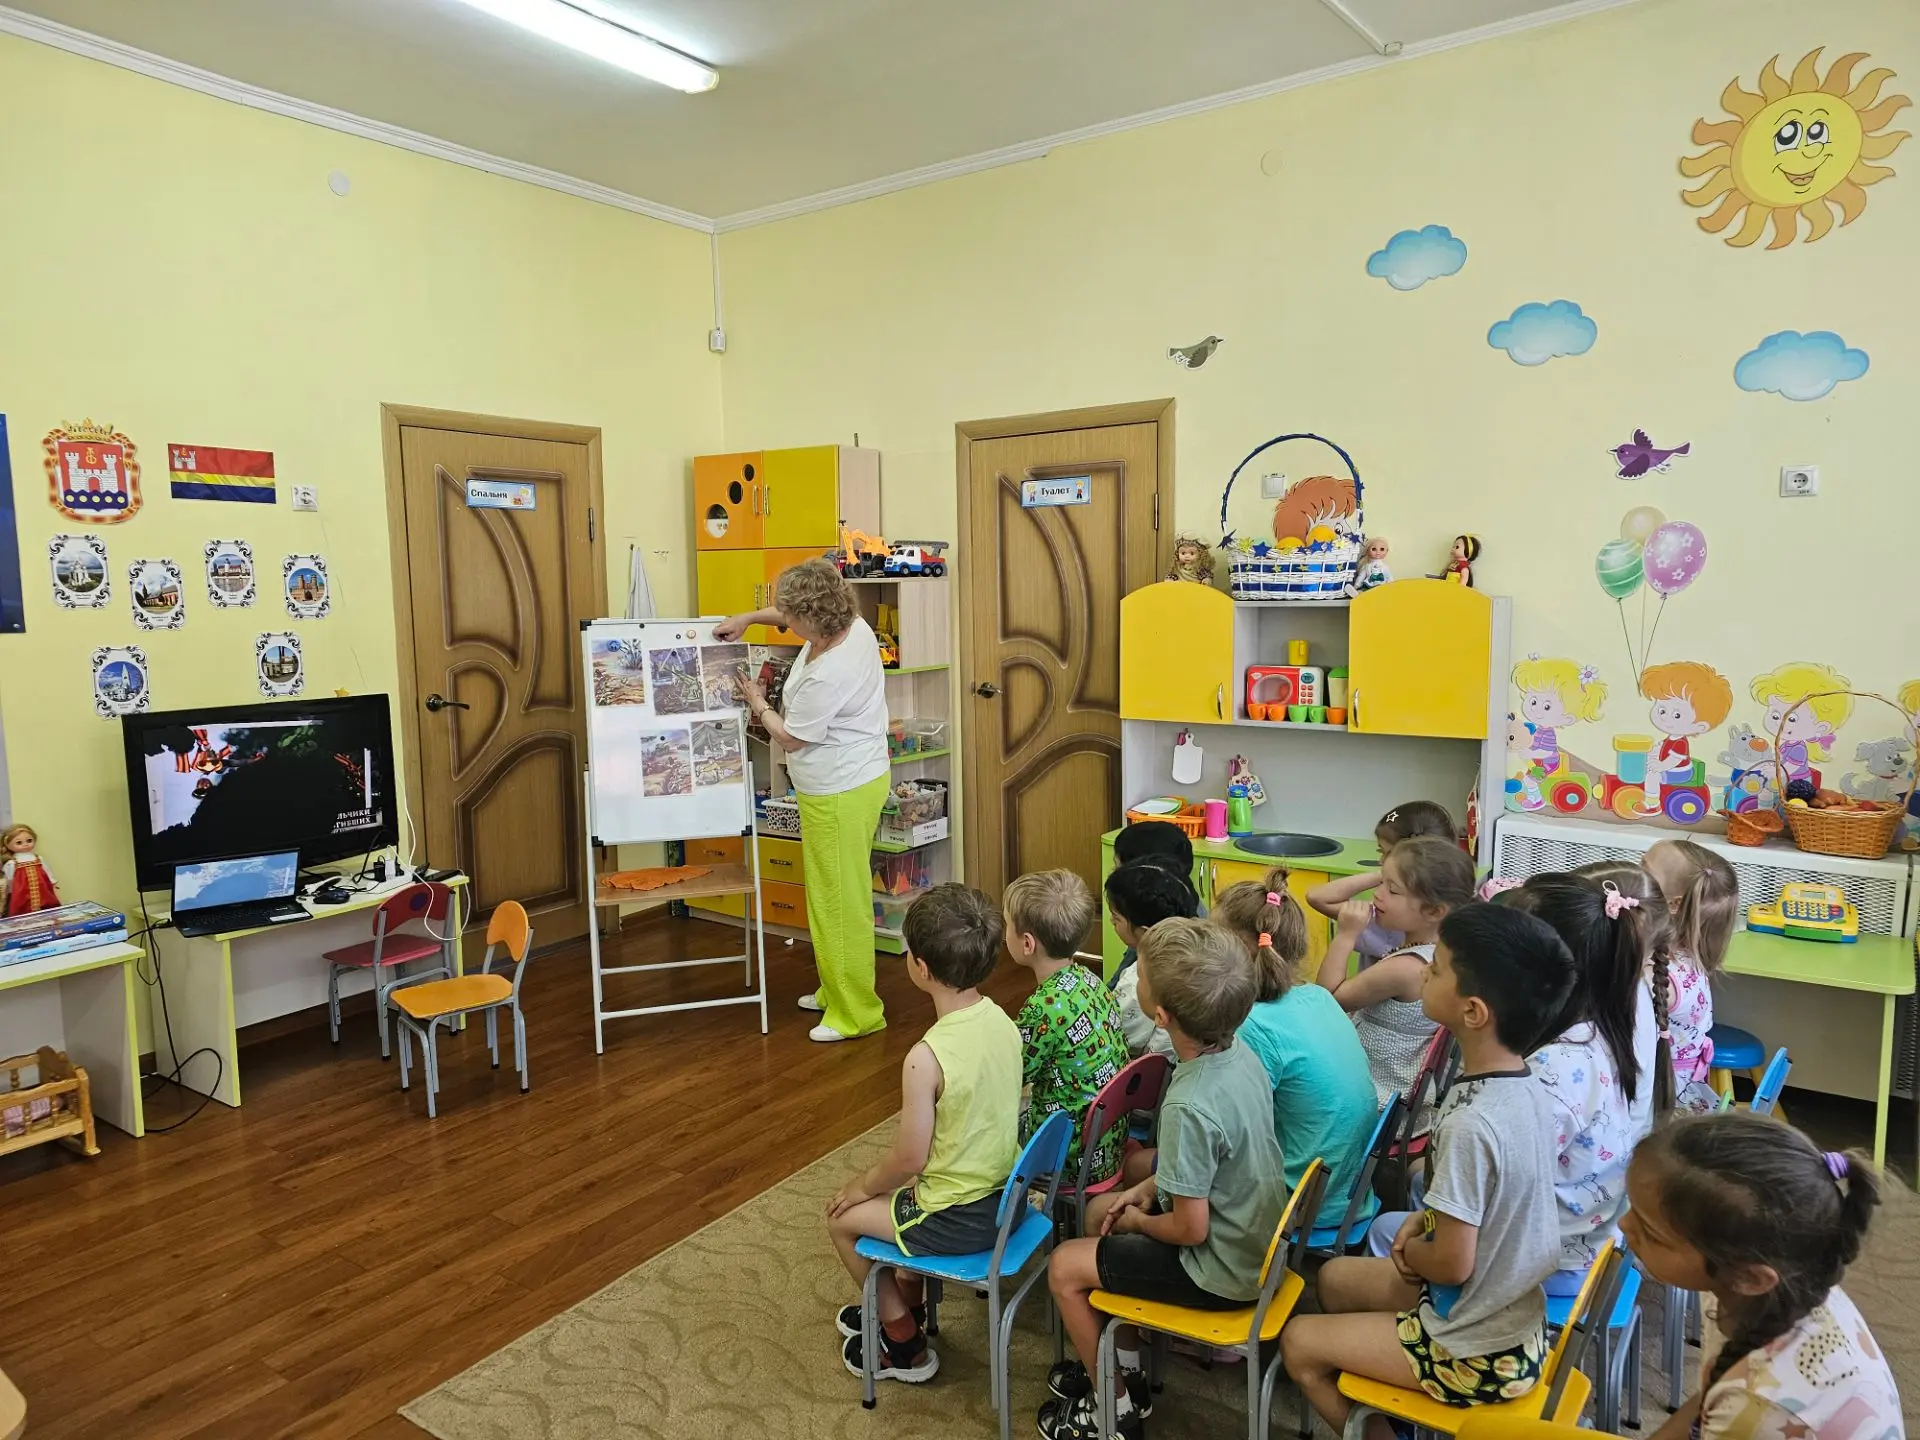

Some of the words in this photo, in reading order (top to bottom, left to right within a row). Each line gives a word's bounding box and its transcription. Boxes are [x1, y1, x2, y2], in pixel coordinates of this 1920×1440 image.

[471, 488, 507, 499] Спальня
[1041, 488, 1070, 497] Туалет
[333, 817, 370, 828] ГИБШИХ
[1066, 1013, 1089, 1038] BLOCK
[1071, 1022, 1093, 1044] MODE
